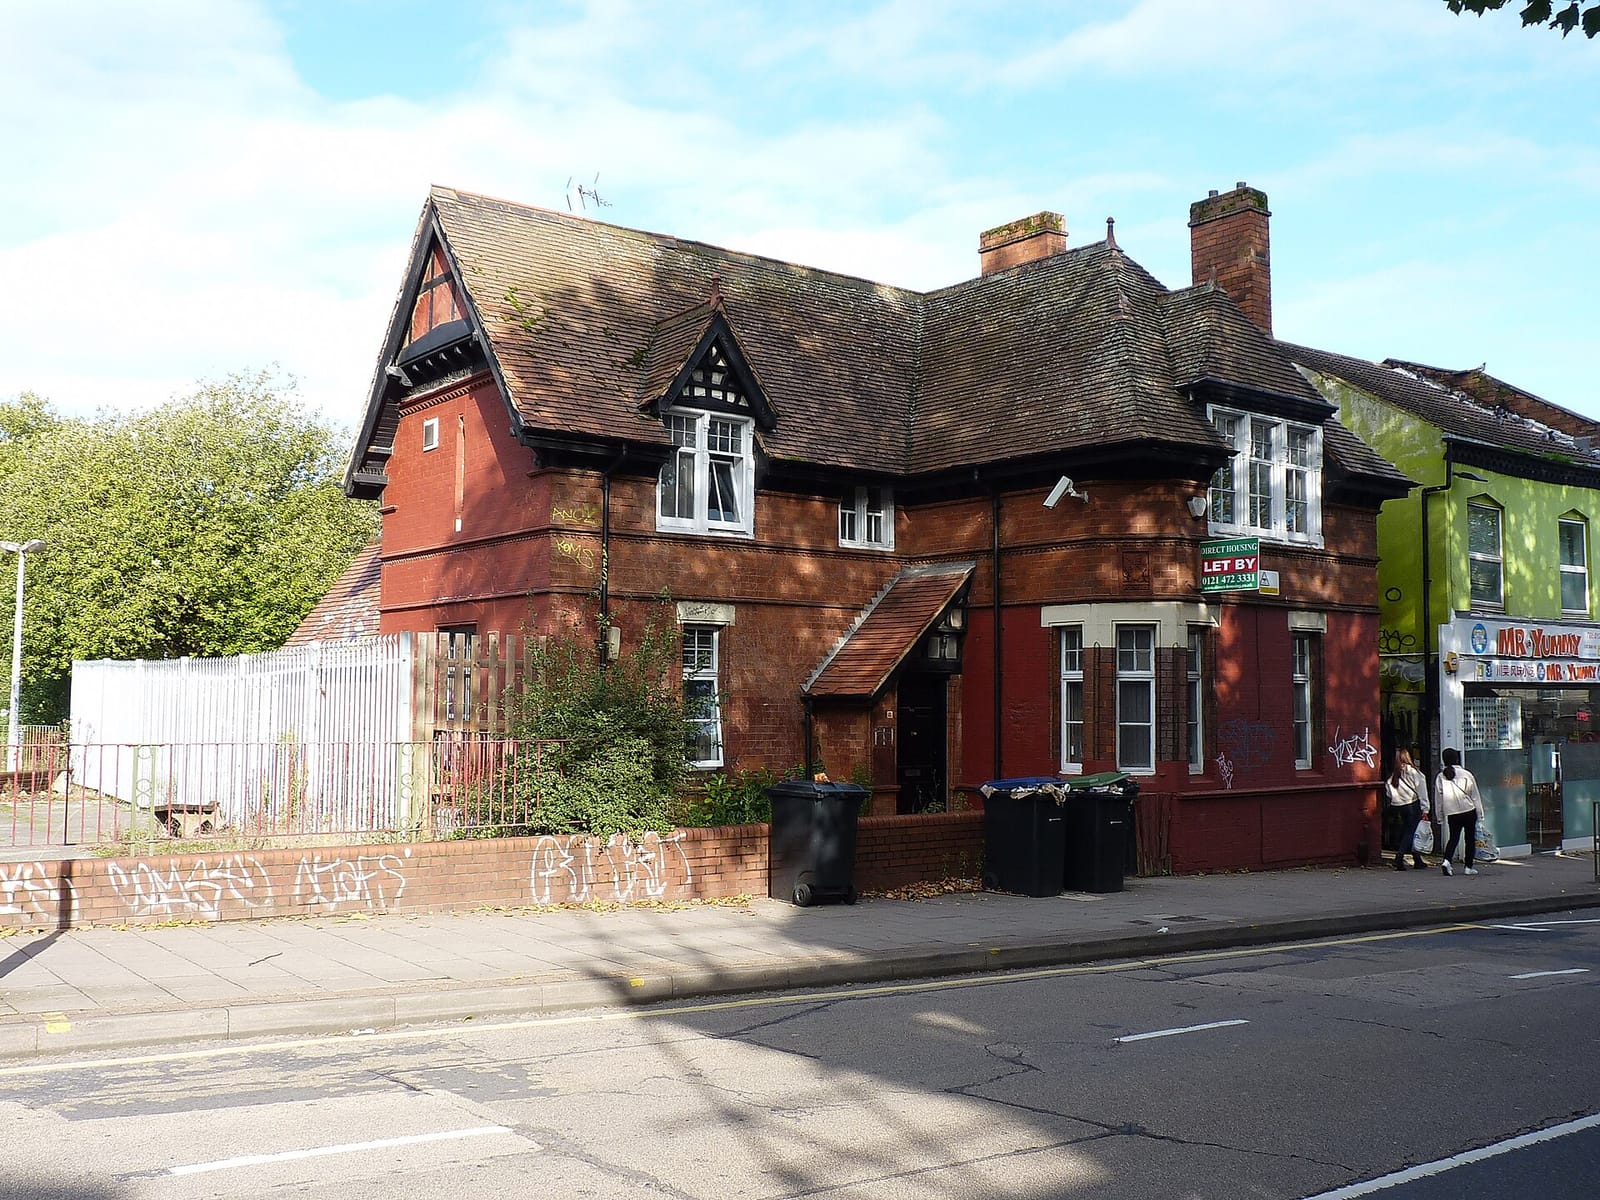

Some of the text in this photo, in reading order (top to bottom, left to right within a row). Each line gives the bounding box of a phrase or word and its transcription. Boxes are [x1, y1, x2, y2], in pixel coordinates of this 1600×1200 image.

[1201, 543, 1257, 554] DIRECT HOUSING
[1203, 558, 1256, 572] LET BY
[1202, 573, 1255, 585] 0121 472 3331
[1498, 627, 1526, 656] MR
[1531, 629, 1581, 657] YUMMY
[1546, 663, 1562, 680] MR
[1567, 663, 1597, 680] YUMMY
